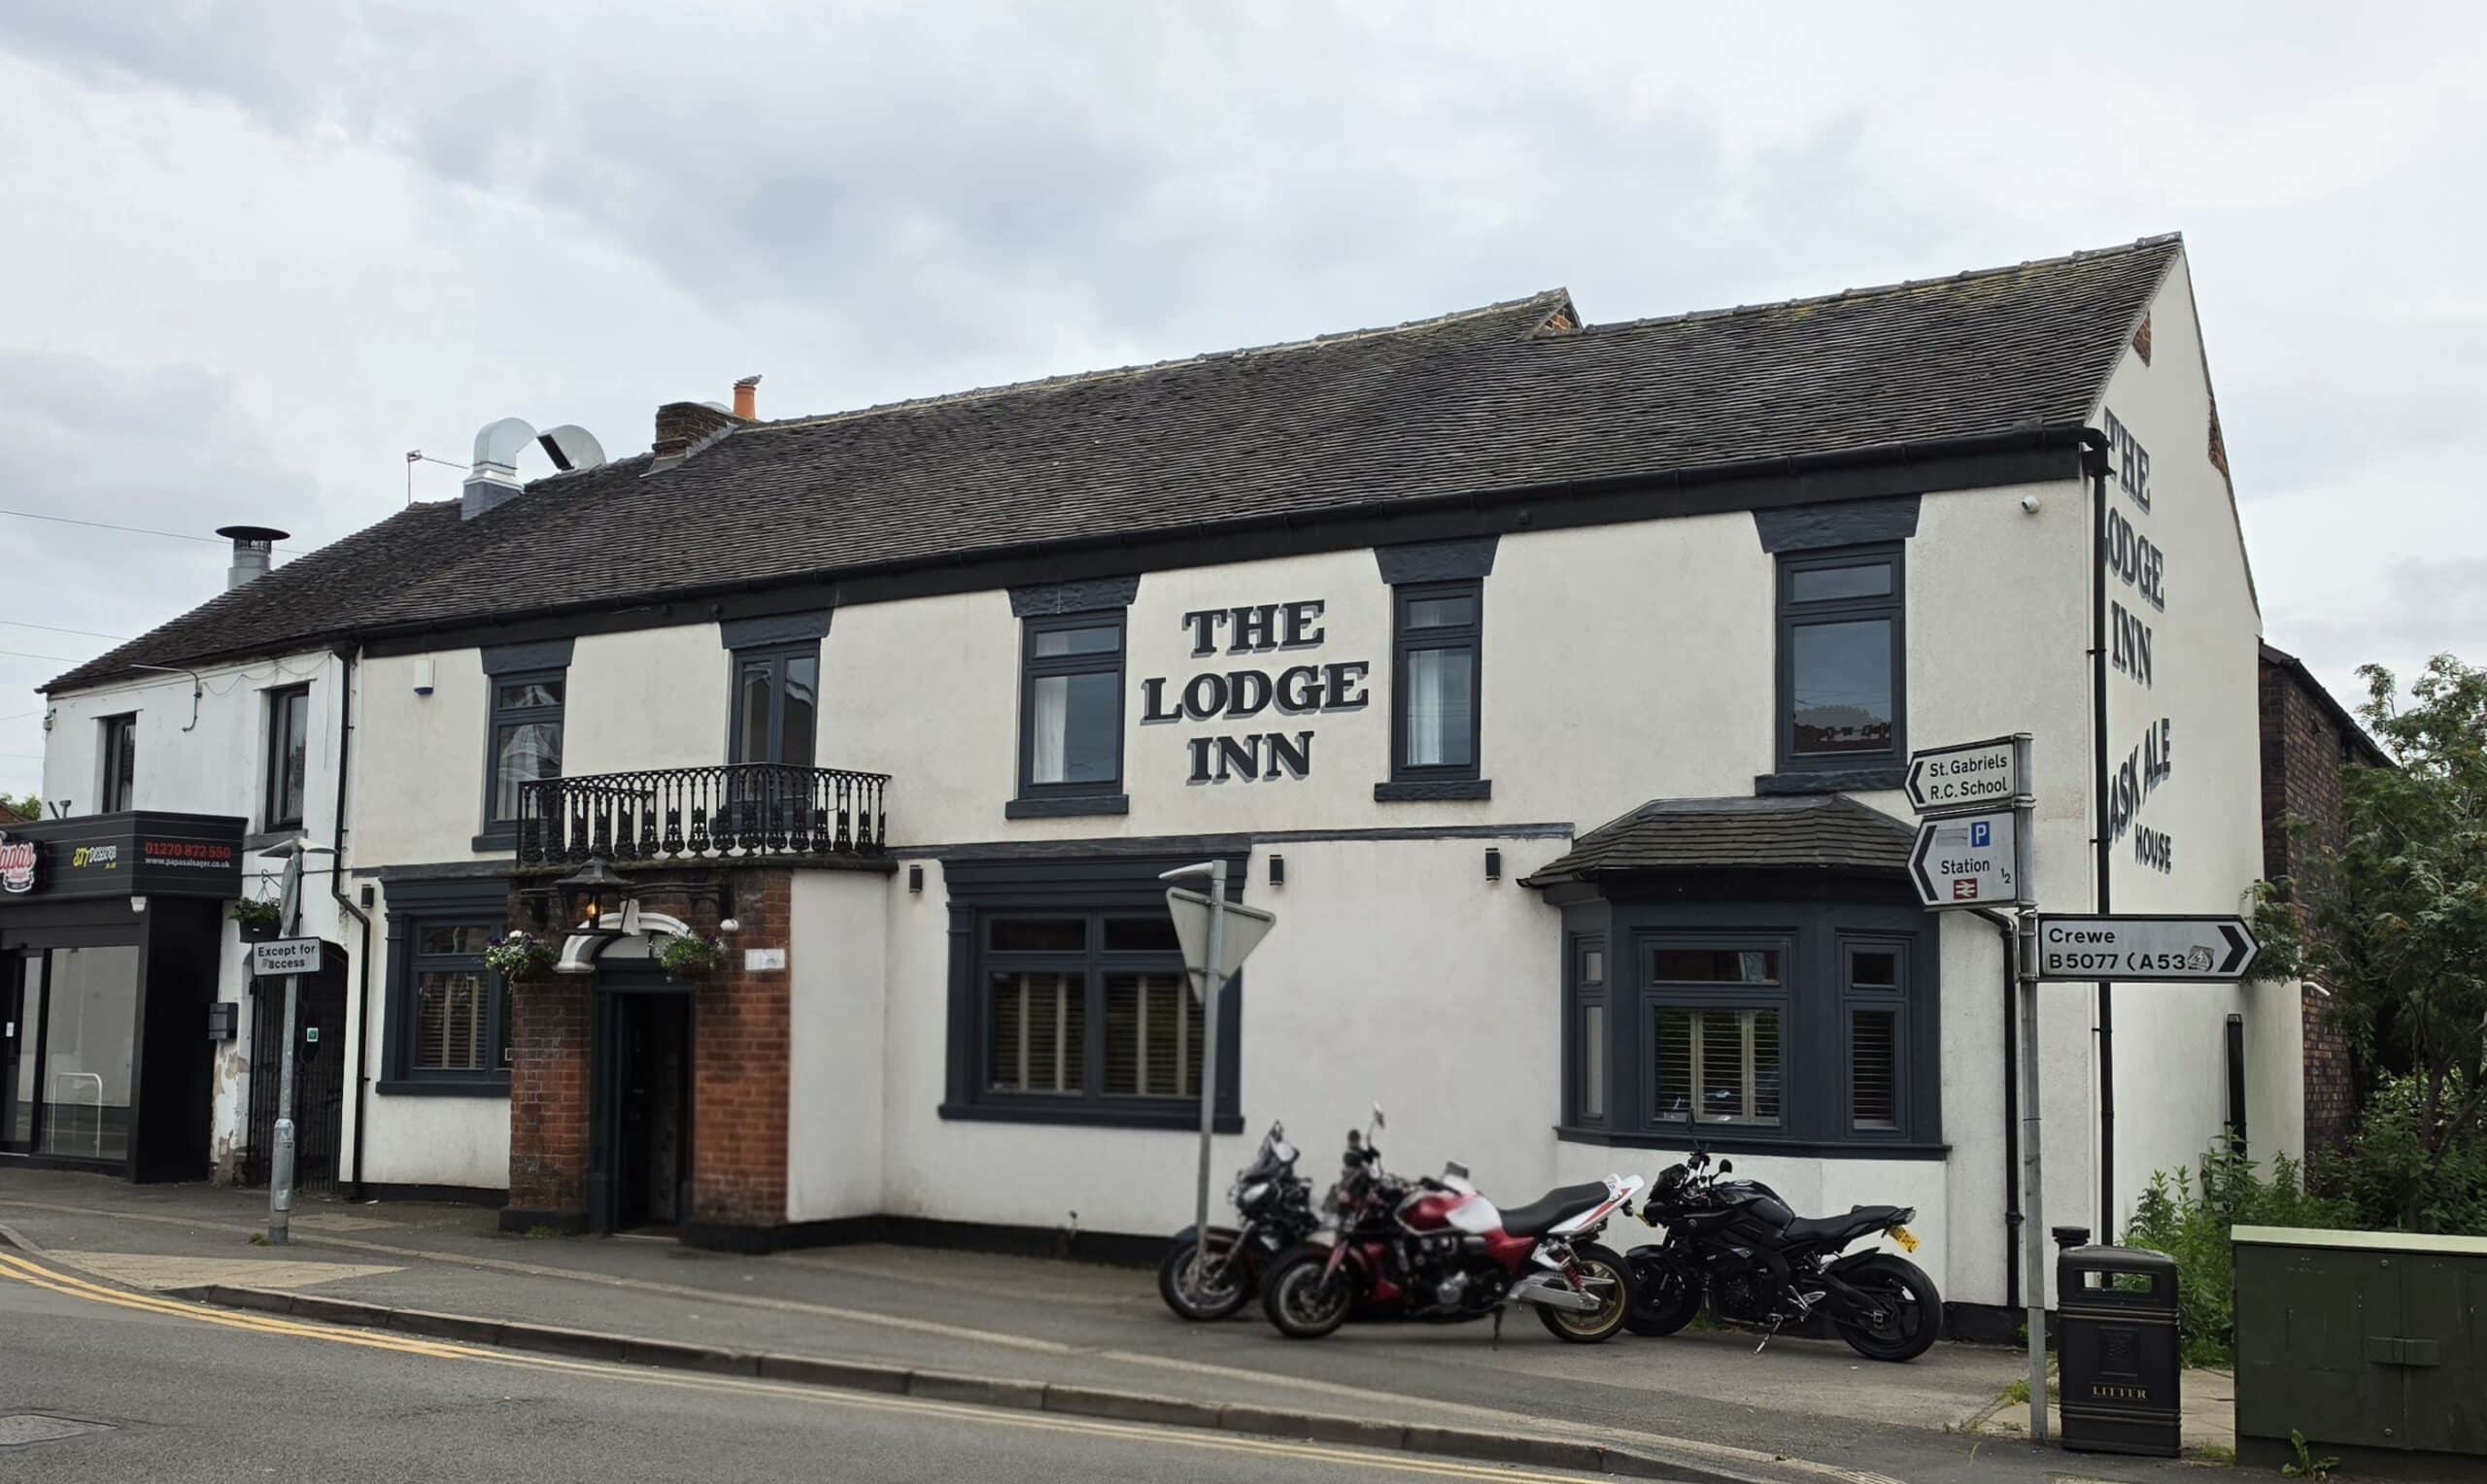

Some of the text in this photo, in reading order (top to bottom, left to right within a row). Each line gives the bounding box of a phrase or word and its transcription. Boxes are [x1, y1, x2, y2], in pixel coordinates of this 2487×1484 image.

[2104, 406, 2150, 515] THE
[2105, 507, 2164, 613] ODGE
[1182, 599, 1324, 658] THE
[2111, 599, 2152, 691] INN
[1140, 661, 1369, 725] LODGE
[1186, 730, 1314, 786] INN
[1929, 754, 2007, 777] St. Gabriels
[1930, 776, 2007, 800] R.C. School
[2108, 718, 2170, 851] ASK ALE
[1975, 824, 1988, 845] P
[145, 842, 183, 857] 01270
[2135, 824, 2171, 874] HOUSE
[1941, 859, 1990, 874] Station
[2049, 928, 2116, 943] Crewe
[258, 944, 316, 957] Except for
[2127, 952, 2214, 972] (A53)
[268, 959, 305, 969] access
[2093, 1385, 2146, 1399] LITTER
